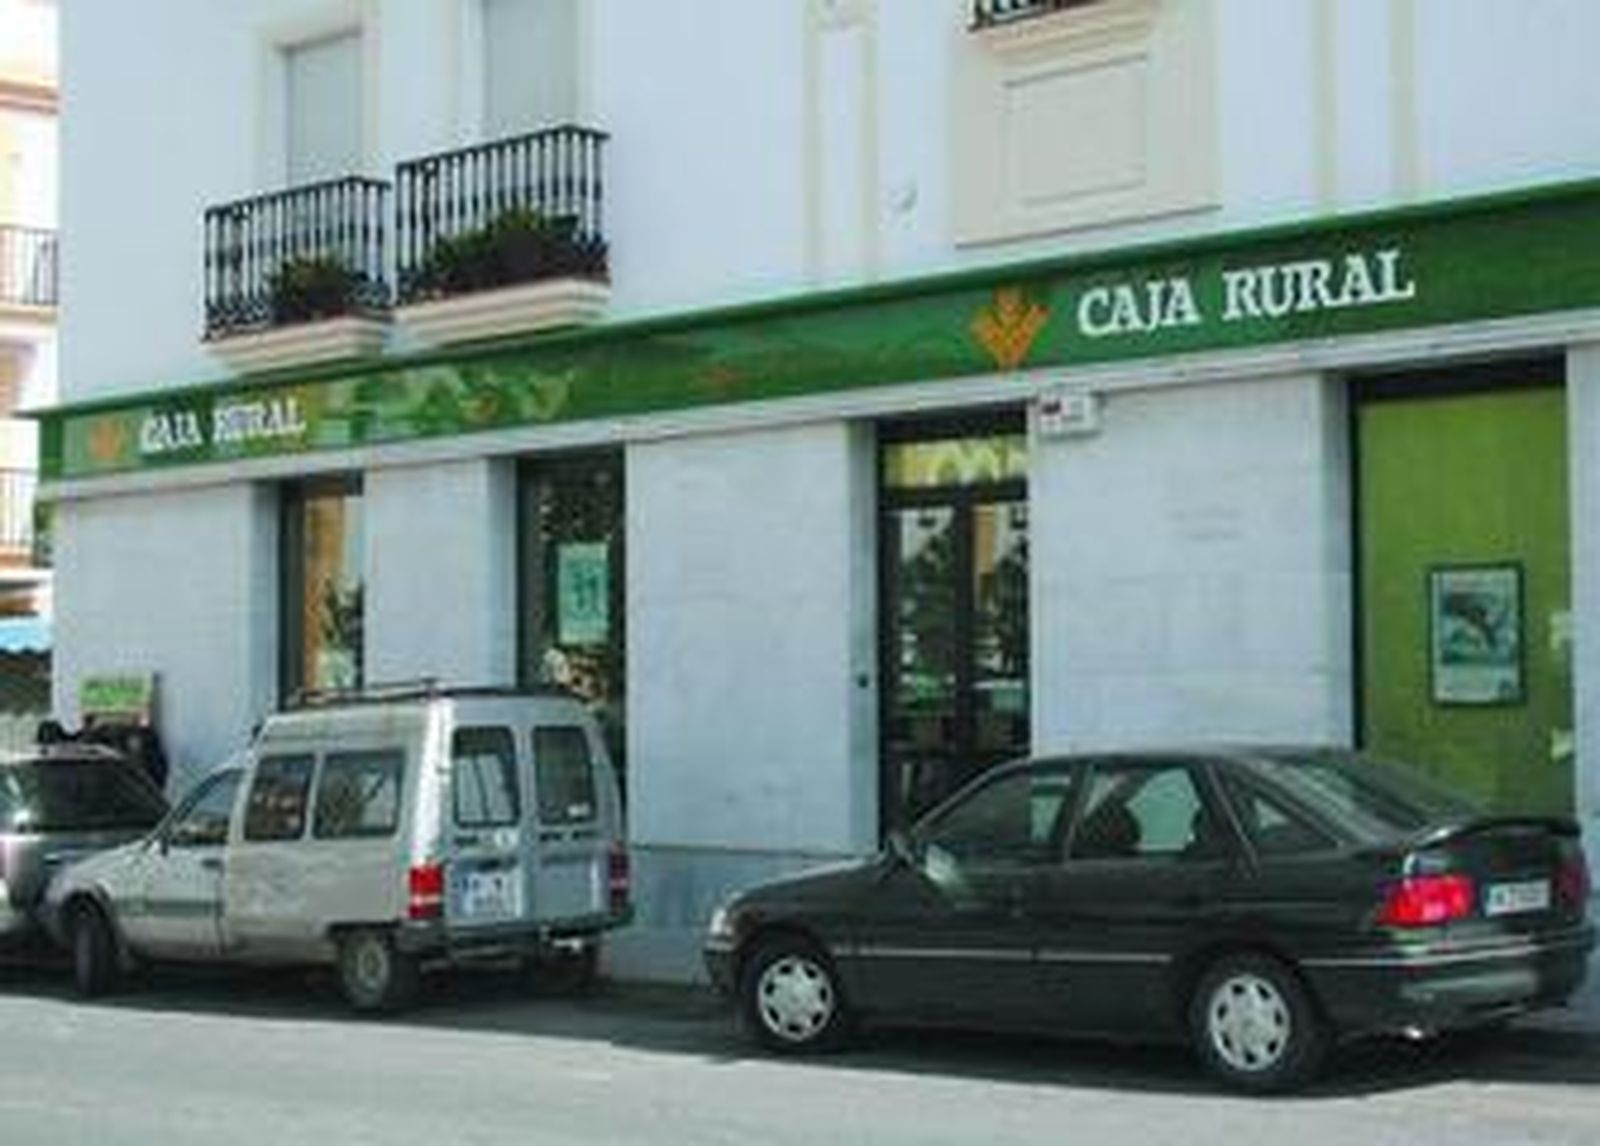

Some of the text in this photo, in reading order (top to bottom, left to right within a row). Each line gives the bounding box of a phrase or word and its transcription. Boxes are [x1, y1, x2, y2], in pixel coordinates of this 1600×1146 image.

[1077, 250, 1415, 337] CAJA RURAL
[140, 397, 307, 452] CAJA RURAL
